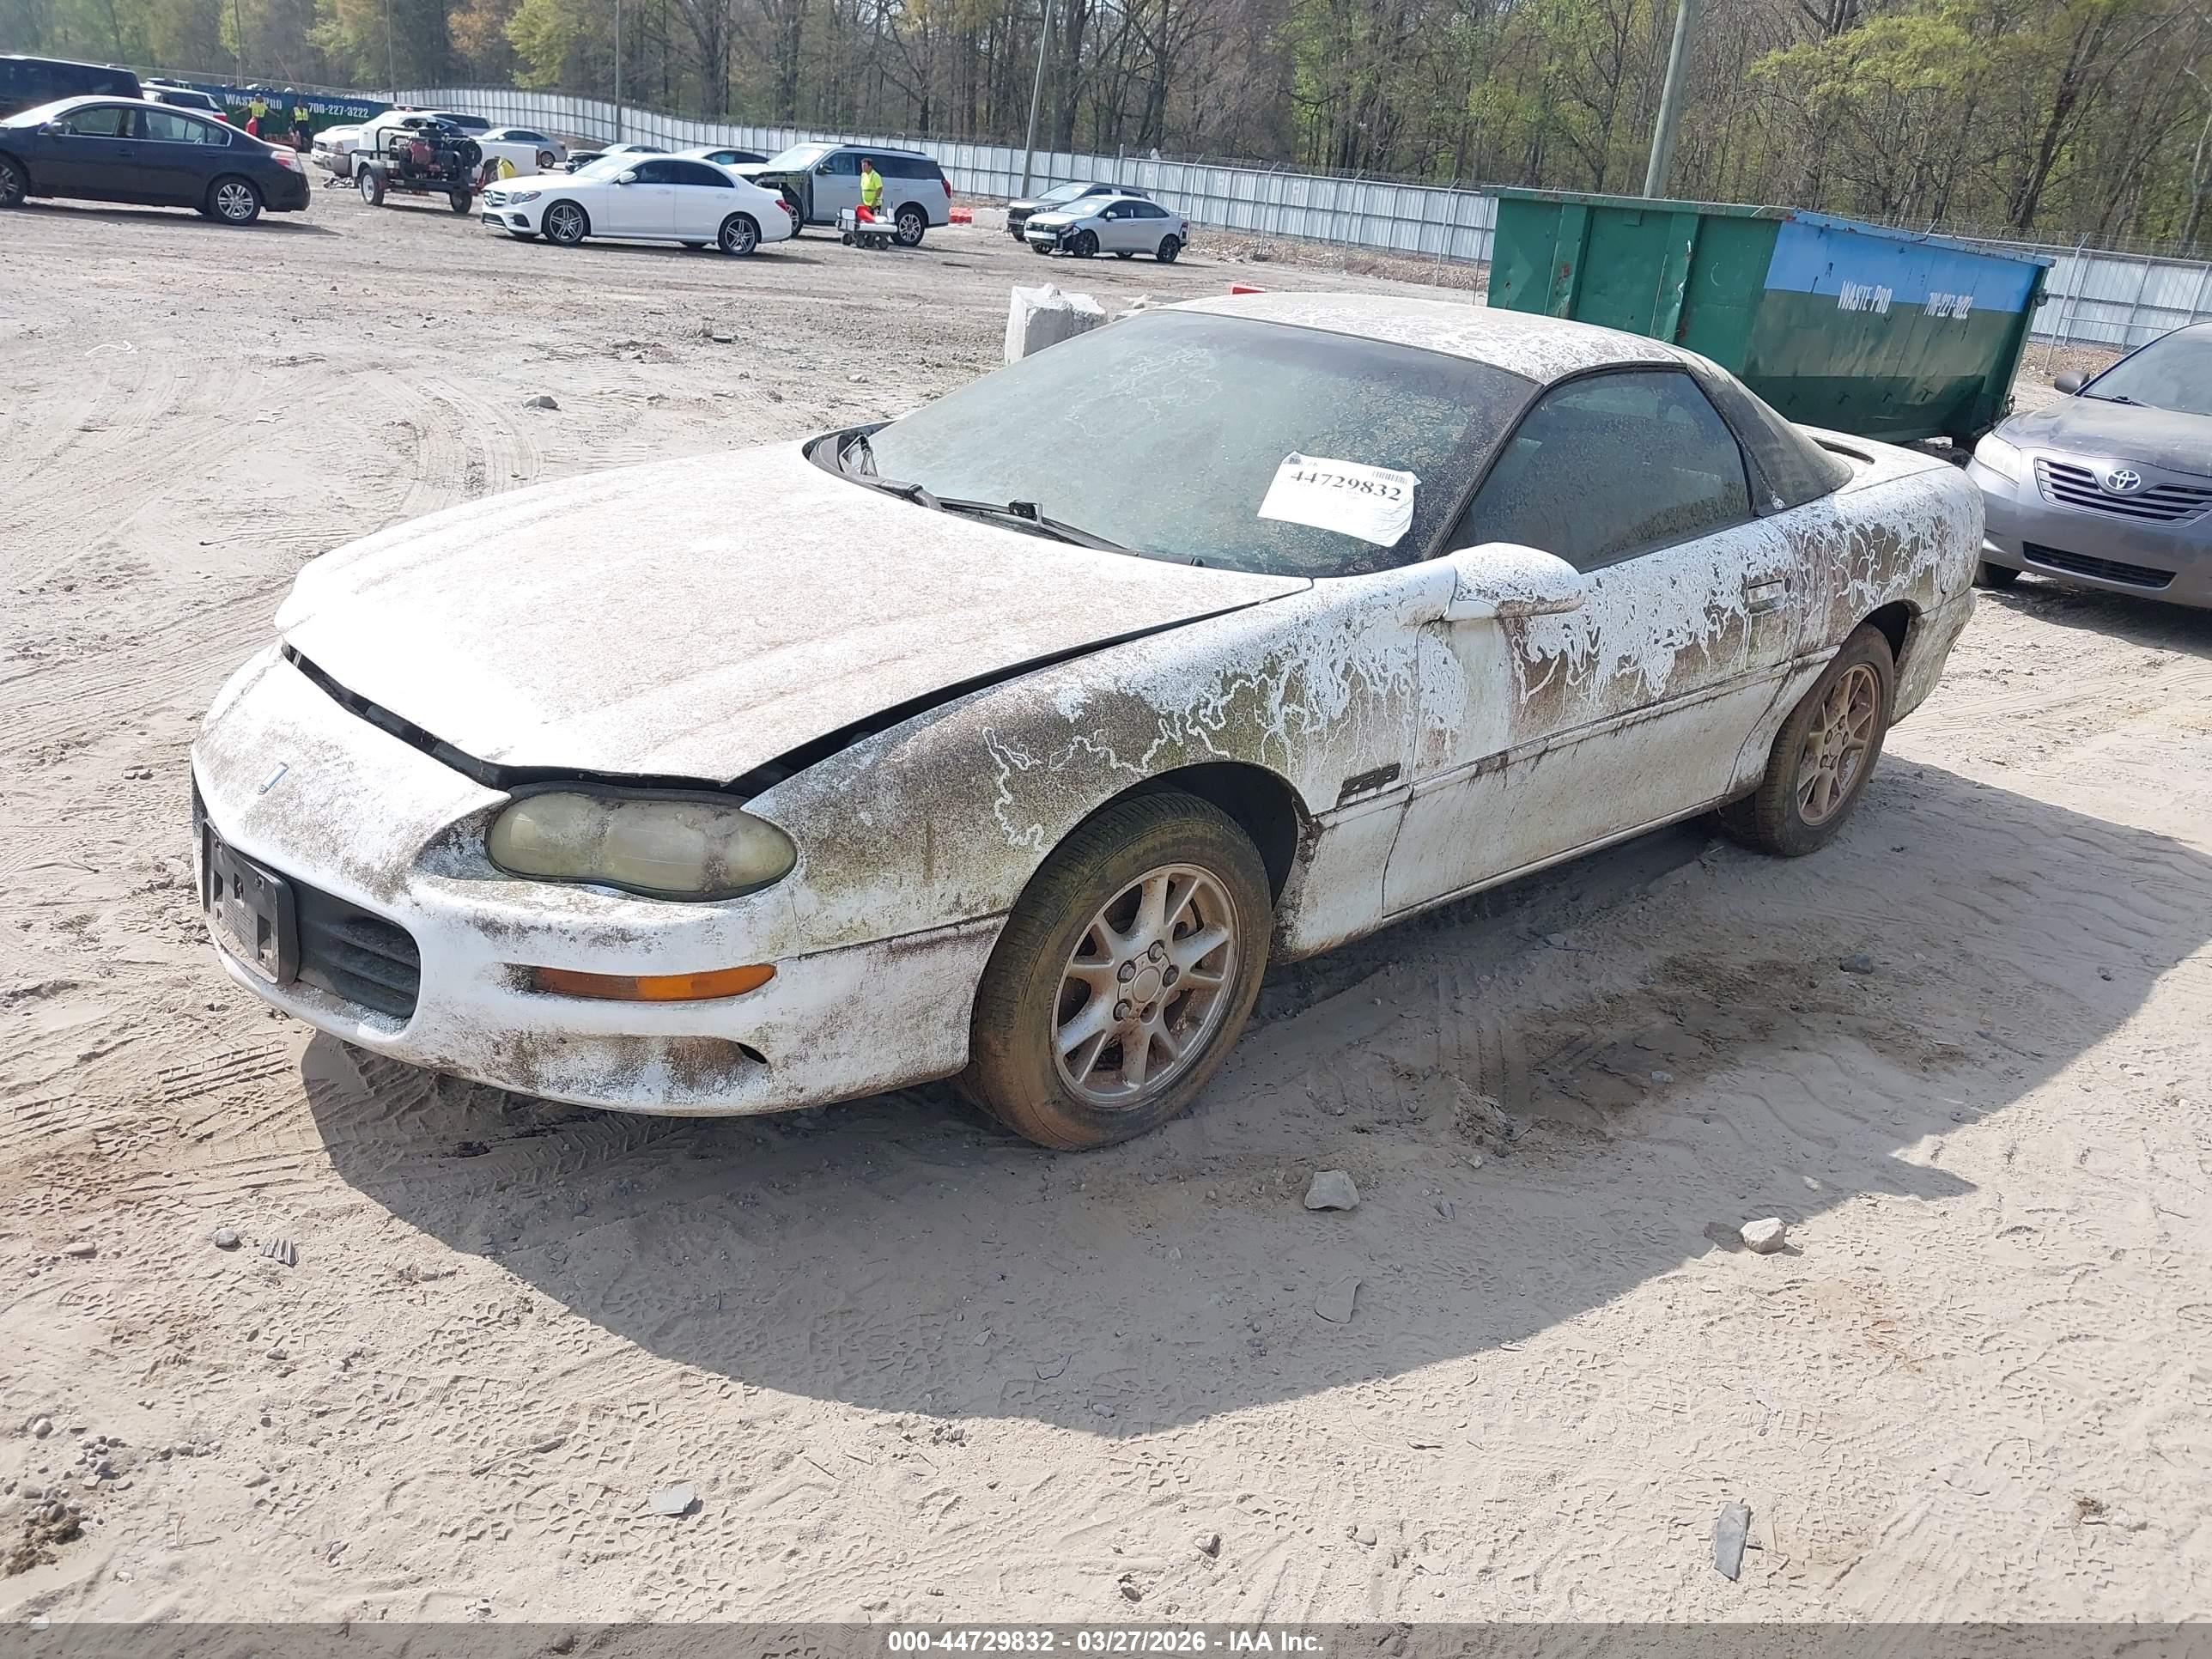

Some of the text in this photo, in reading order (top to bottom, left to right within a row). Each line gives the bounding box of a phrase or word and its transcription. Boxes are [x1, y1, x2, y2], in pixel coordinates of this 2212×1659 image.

[225, 94, 257, 107] WAST
[1838, 280, 1893, 314] WASTE PRO
[1291, 471, 1401, 501] 44729832
